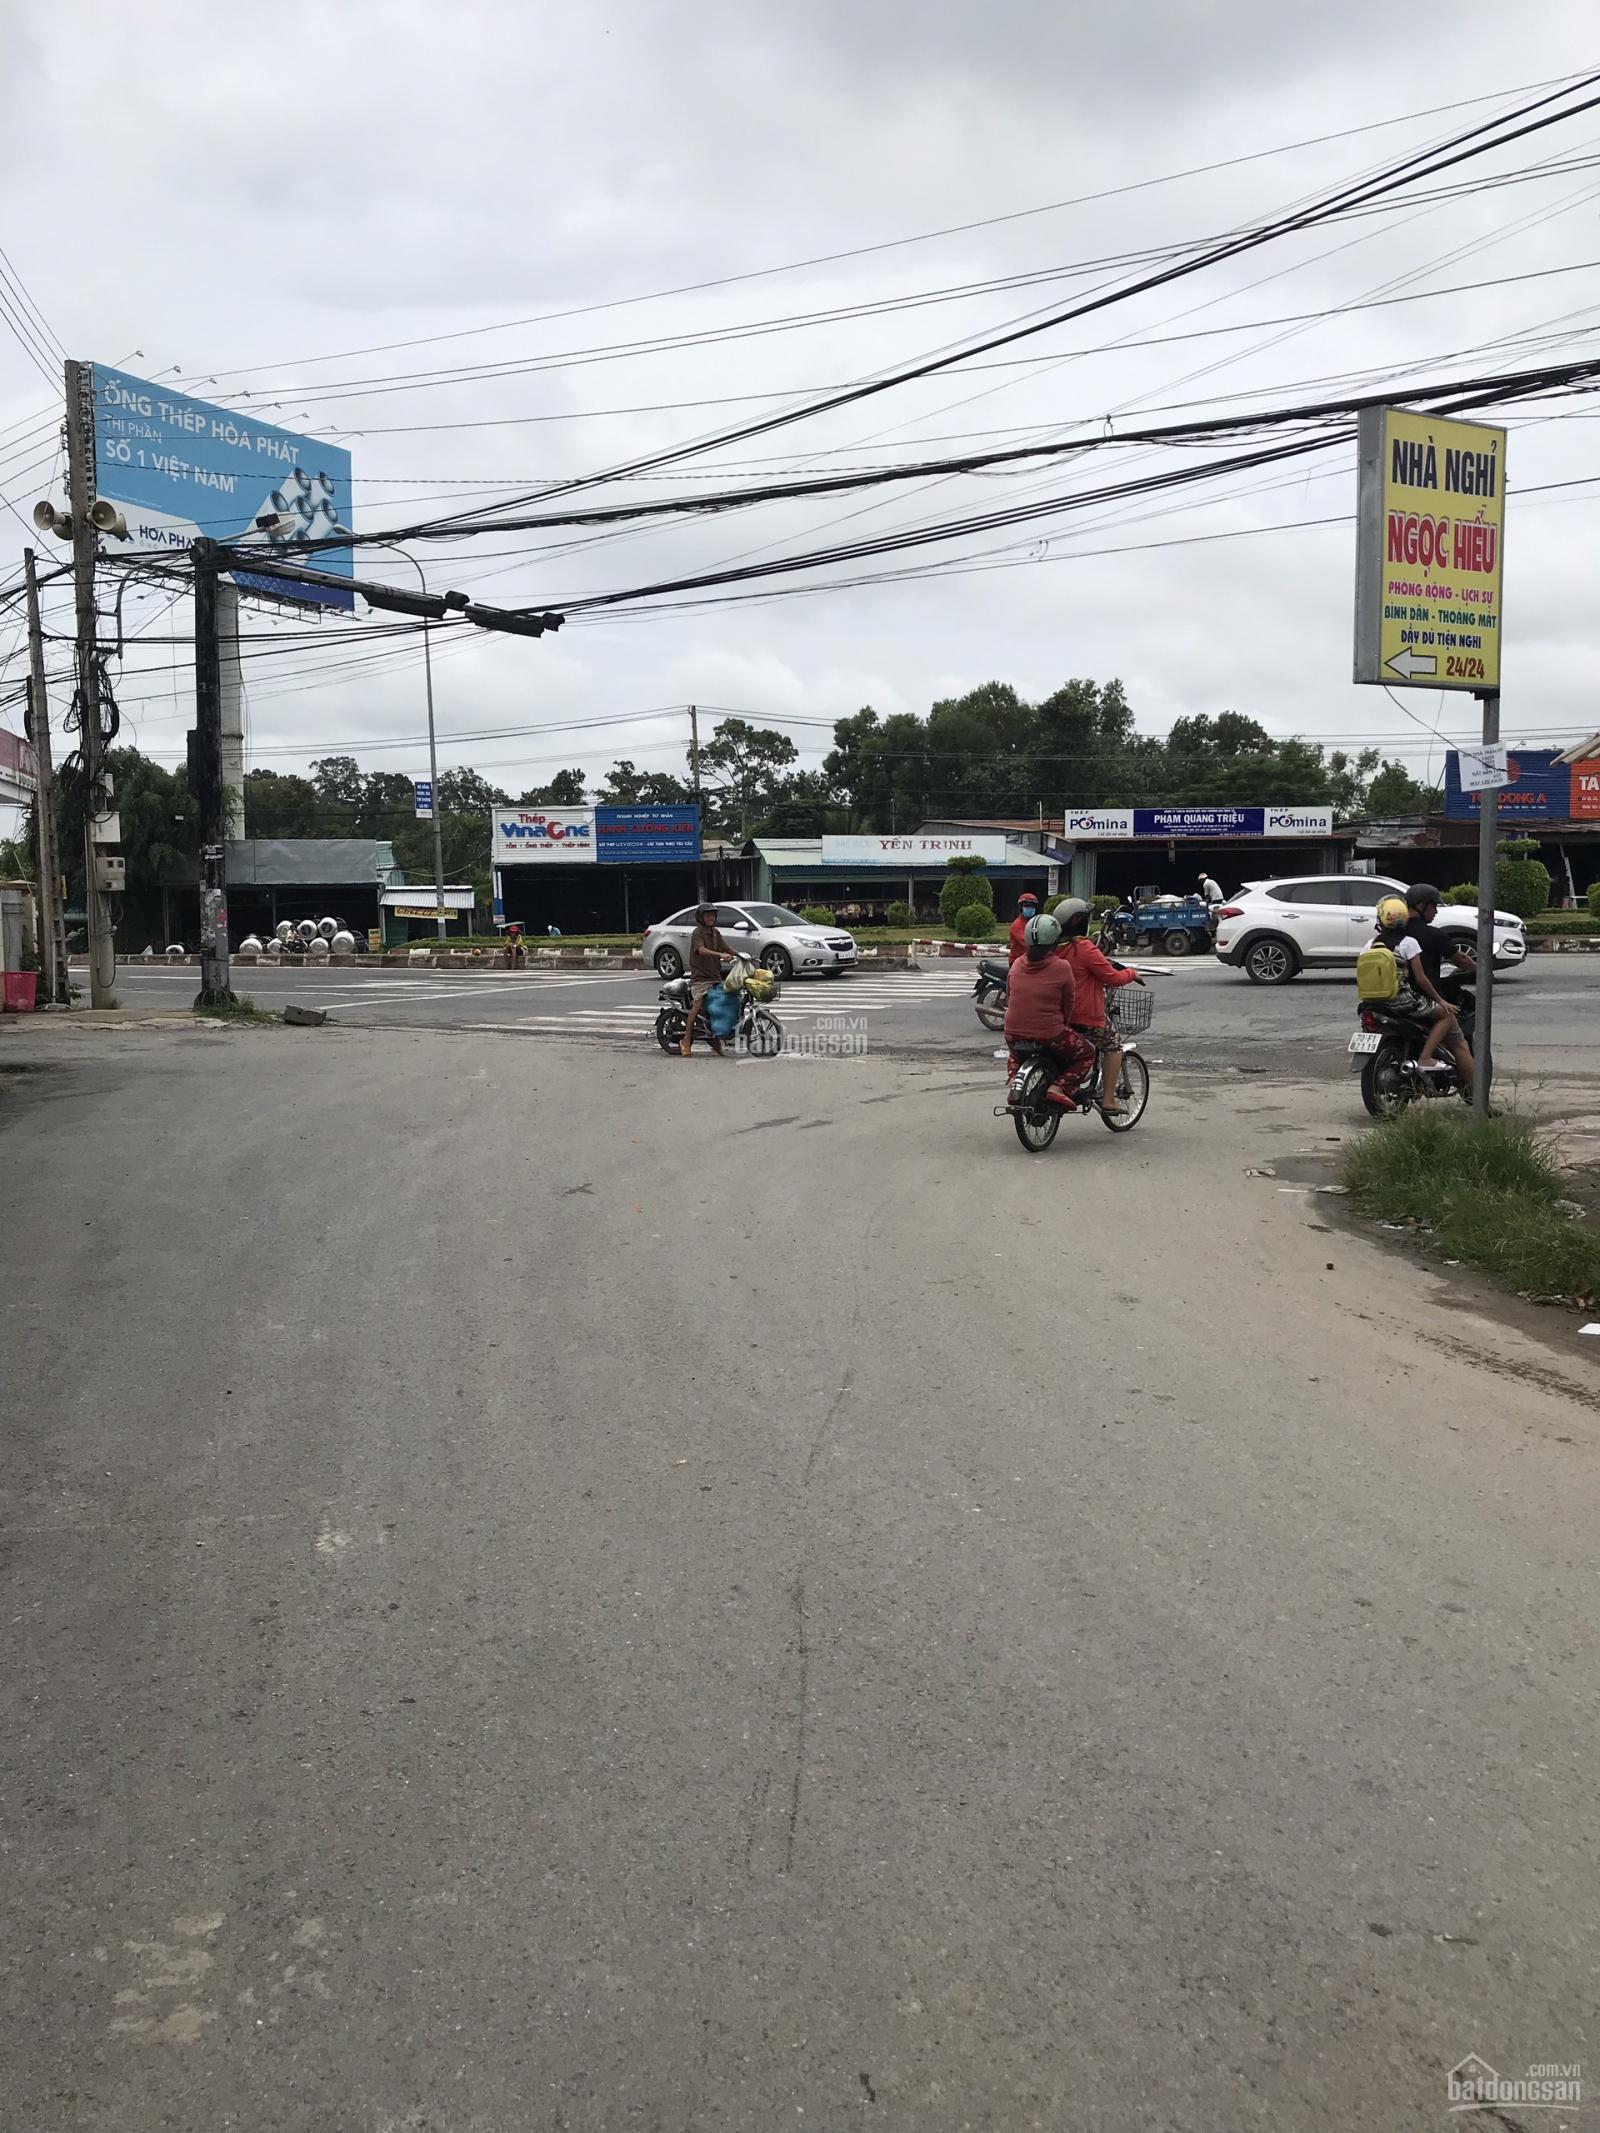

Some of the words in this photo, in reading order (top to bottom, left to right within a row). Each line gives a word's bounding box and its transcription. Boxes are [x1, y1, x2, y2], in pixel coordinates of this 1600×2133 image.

[104, 380, 152, 417] ỐNG
[158, 401, 207, 433] THÉP
[211, 416, 251, 450] HÒA
[256, 438, 300, 464] PHÁT
[128, 421, 162, 444] PHẦN
[106, 437, 131, 462] SỐ
[137, 449, 146, 467] 1
[152, 453, 190, 482] VIỆT
[195, 466, 235, 493] NAM
[1392, 435, 1438, 489] NHÀ
[1445, 440, 1497, 498] NGHỈ
[1388, 509, 1449, 578] NGỌC
[1388, 577, 1423, 597] PHÒNG
[1425, 581, 1452, 603] RỘNG
[1462, 588, 1479, 606] LỊCH
[1482, 591, 1494, 609] SỰ
[1385, 601, 1407, 619] BÌNH
[1409, 604, 1429, 621] DÂN
[1438, 607, 1475, 626] THOÁNG
[1437, 629, 1456, 650] TIỆN
[1459, 634, 1482, 648] NGHI
[1446, 656, 1485, 679] 24/24
[519, 813, 546, 825] Thép
[1154, 814, 1181, 825] PHẠM
[1184, 814, 1214, 825] QUANG
[1217, 811, 1245, 824] TRIỆU
[880, 836, 913, 850] YẾN
